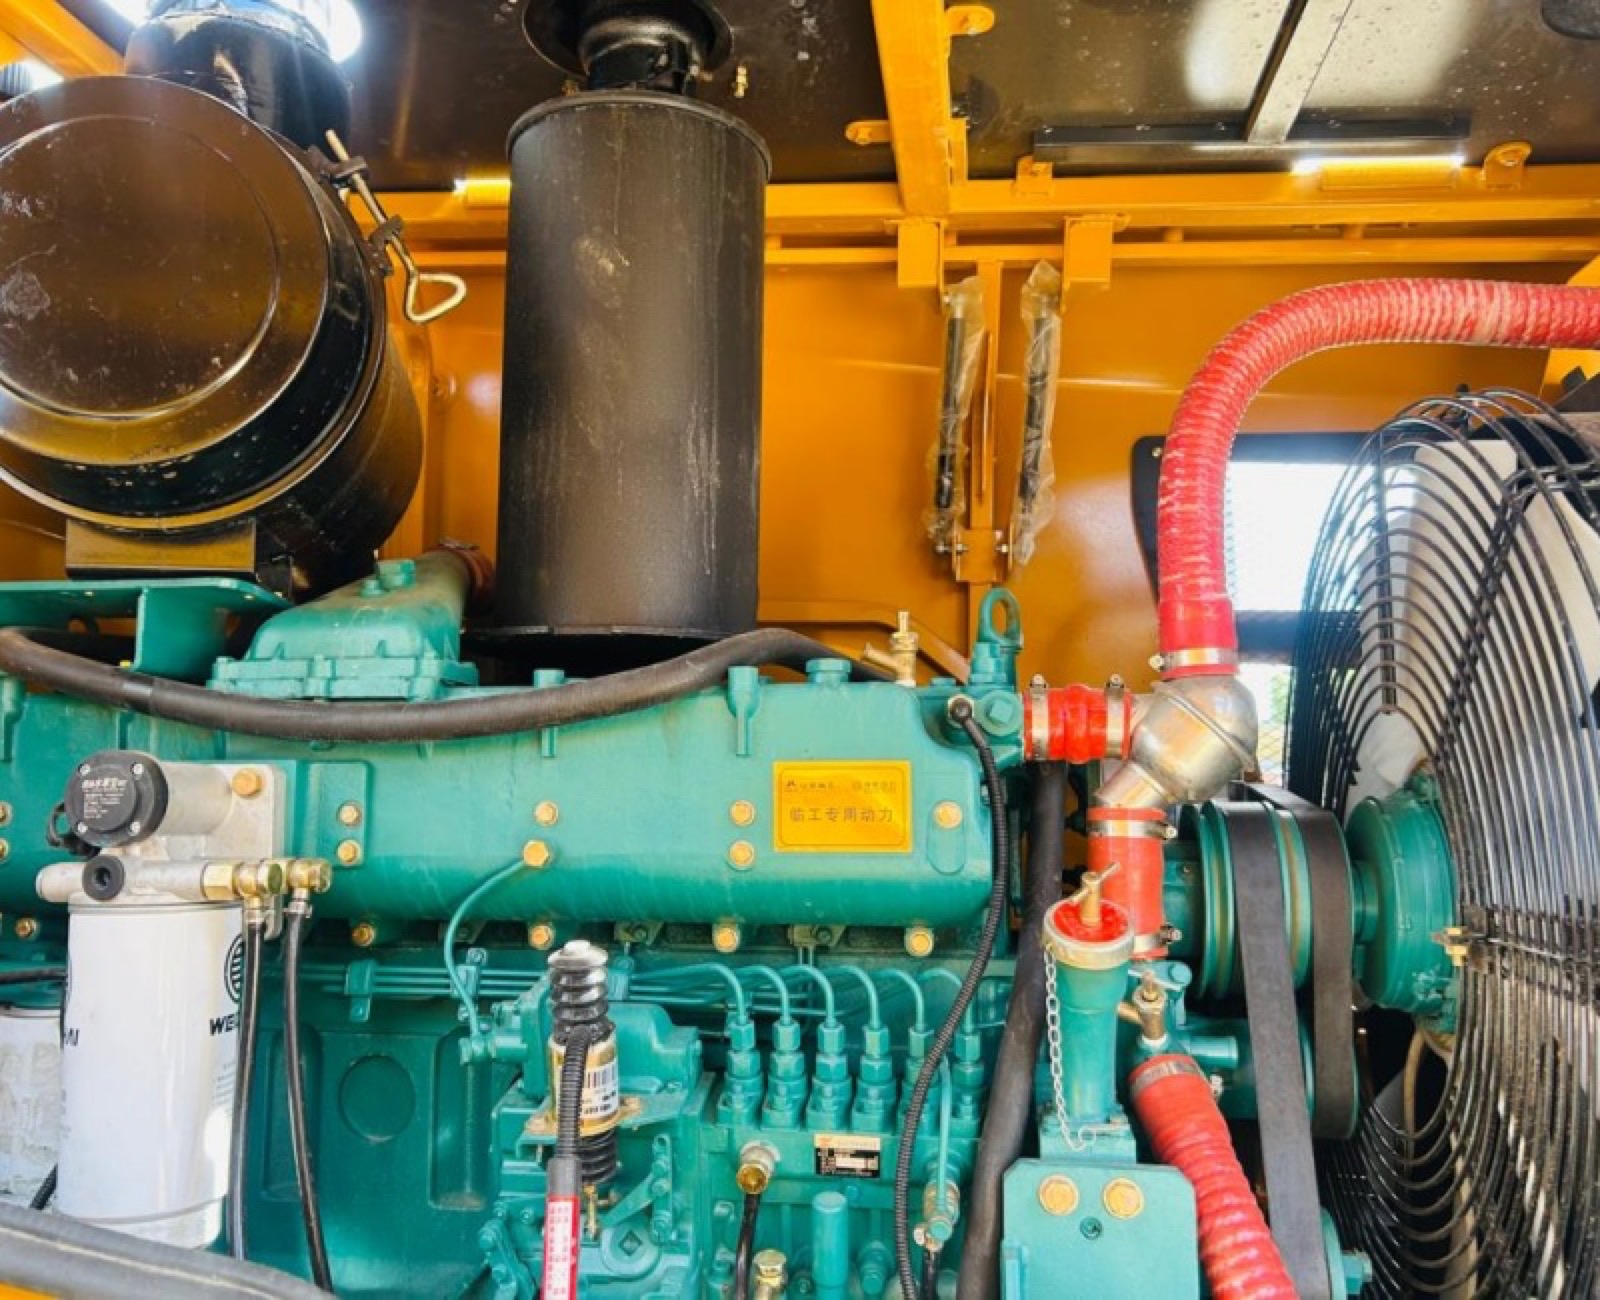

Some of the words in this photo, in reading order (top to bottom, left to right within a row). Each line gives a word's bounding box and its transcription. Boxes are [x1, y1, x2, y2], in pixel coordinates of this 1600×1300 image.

[789, 806, 893, 823] 临工专用动力
[209, 1013, 239, 1036] WE
